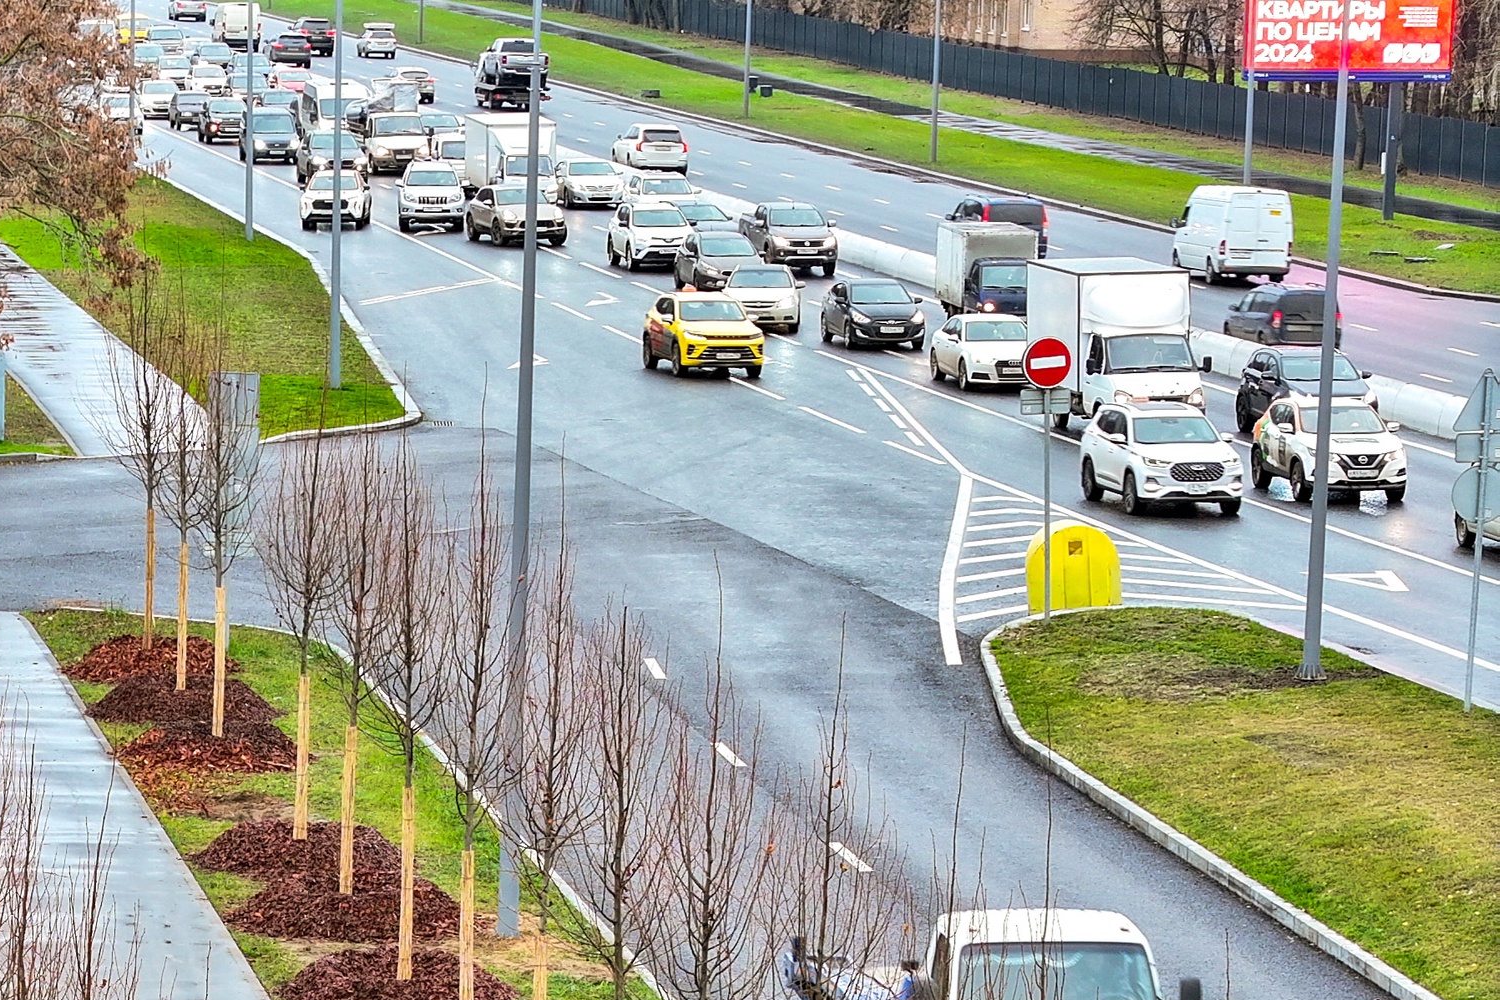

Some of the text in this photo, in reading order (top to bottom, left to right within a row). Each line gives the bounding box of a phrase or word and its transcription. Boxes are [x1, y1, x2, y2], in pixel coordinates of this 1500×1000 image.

[1257, 0, 1386, 19] КВАРТИРЫ
[1256, 21, 1381, 44] ПО ЦЕНАМ
[1253, 42, 1315, 63] 2024
